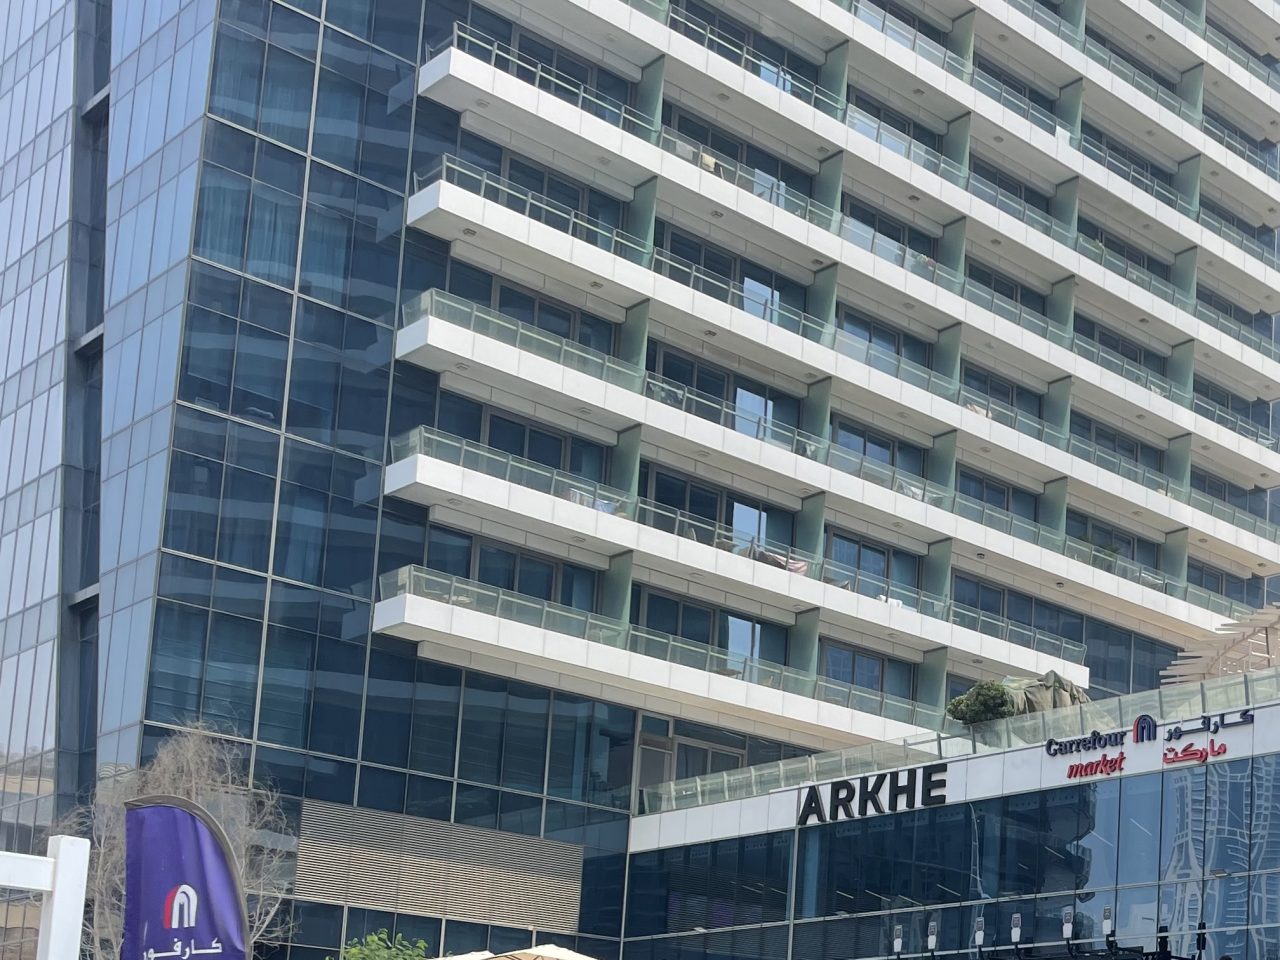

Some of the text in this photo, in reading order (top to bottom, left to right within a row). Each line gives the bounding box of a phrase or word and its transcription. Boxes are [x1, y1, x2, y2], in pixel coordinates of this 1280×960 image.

[1163, 709, 1254, 742] كارفور
[1046, 729, 1127, 757] Carrefour
[1162, 738, 1227, 764] ماركت
[1067, 751, 1126, 779] market
[798, 763, 948, 825] ARKHE
